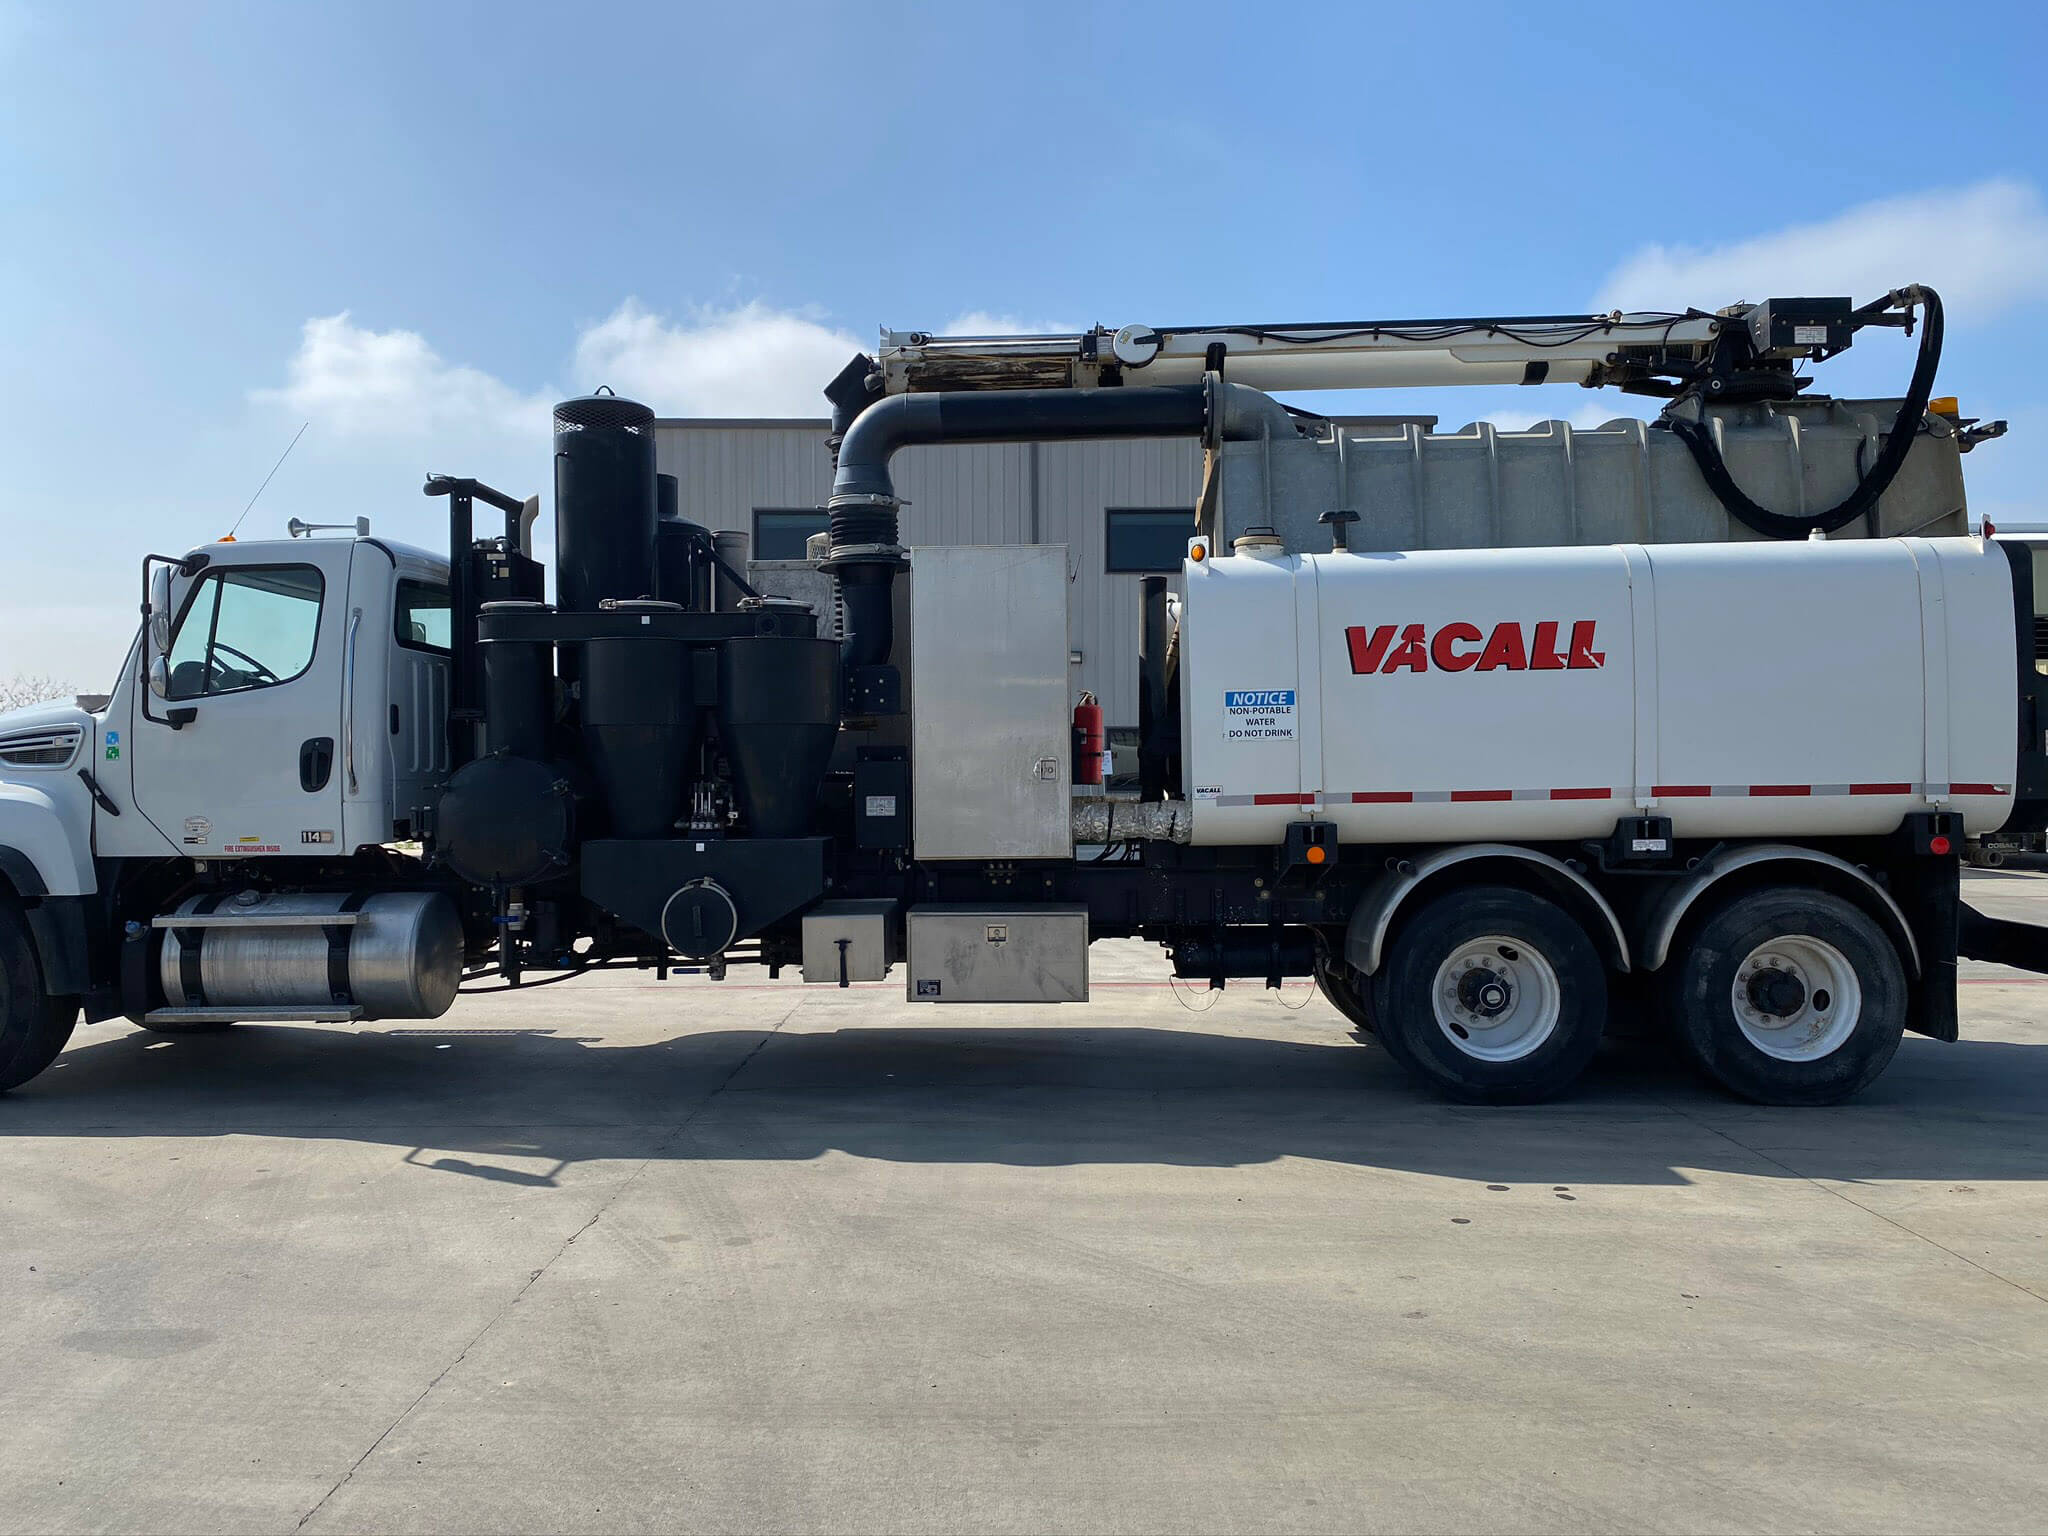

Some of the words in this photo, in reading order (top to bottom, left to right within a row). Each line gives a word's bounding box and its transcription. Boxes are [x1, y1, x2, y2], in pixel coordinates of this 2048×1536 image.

[1345, 621, 1606, 674] VACALL
[1232, 692, 1288, 706] NOTICE
[1229, 706, 1291, 715] NON-POTABLE
[1246, 718, 1275, 726] WATER
[1265, 729, 1292, 737] DRINK
[302, 831, 320, 842] 114
